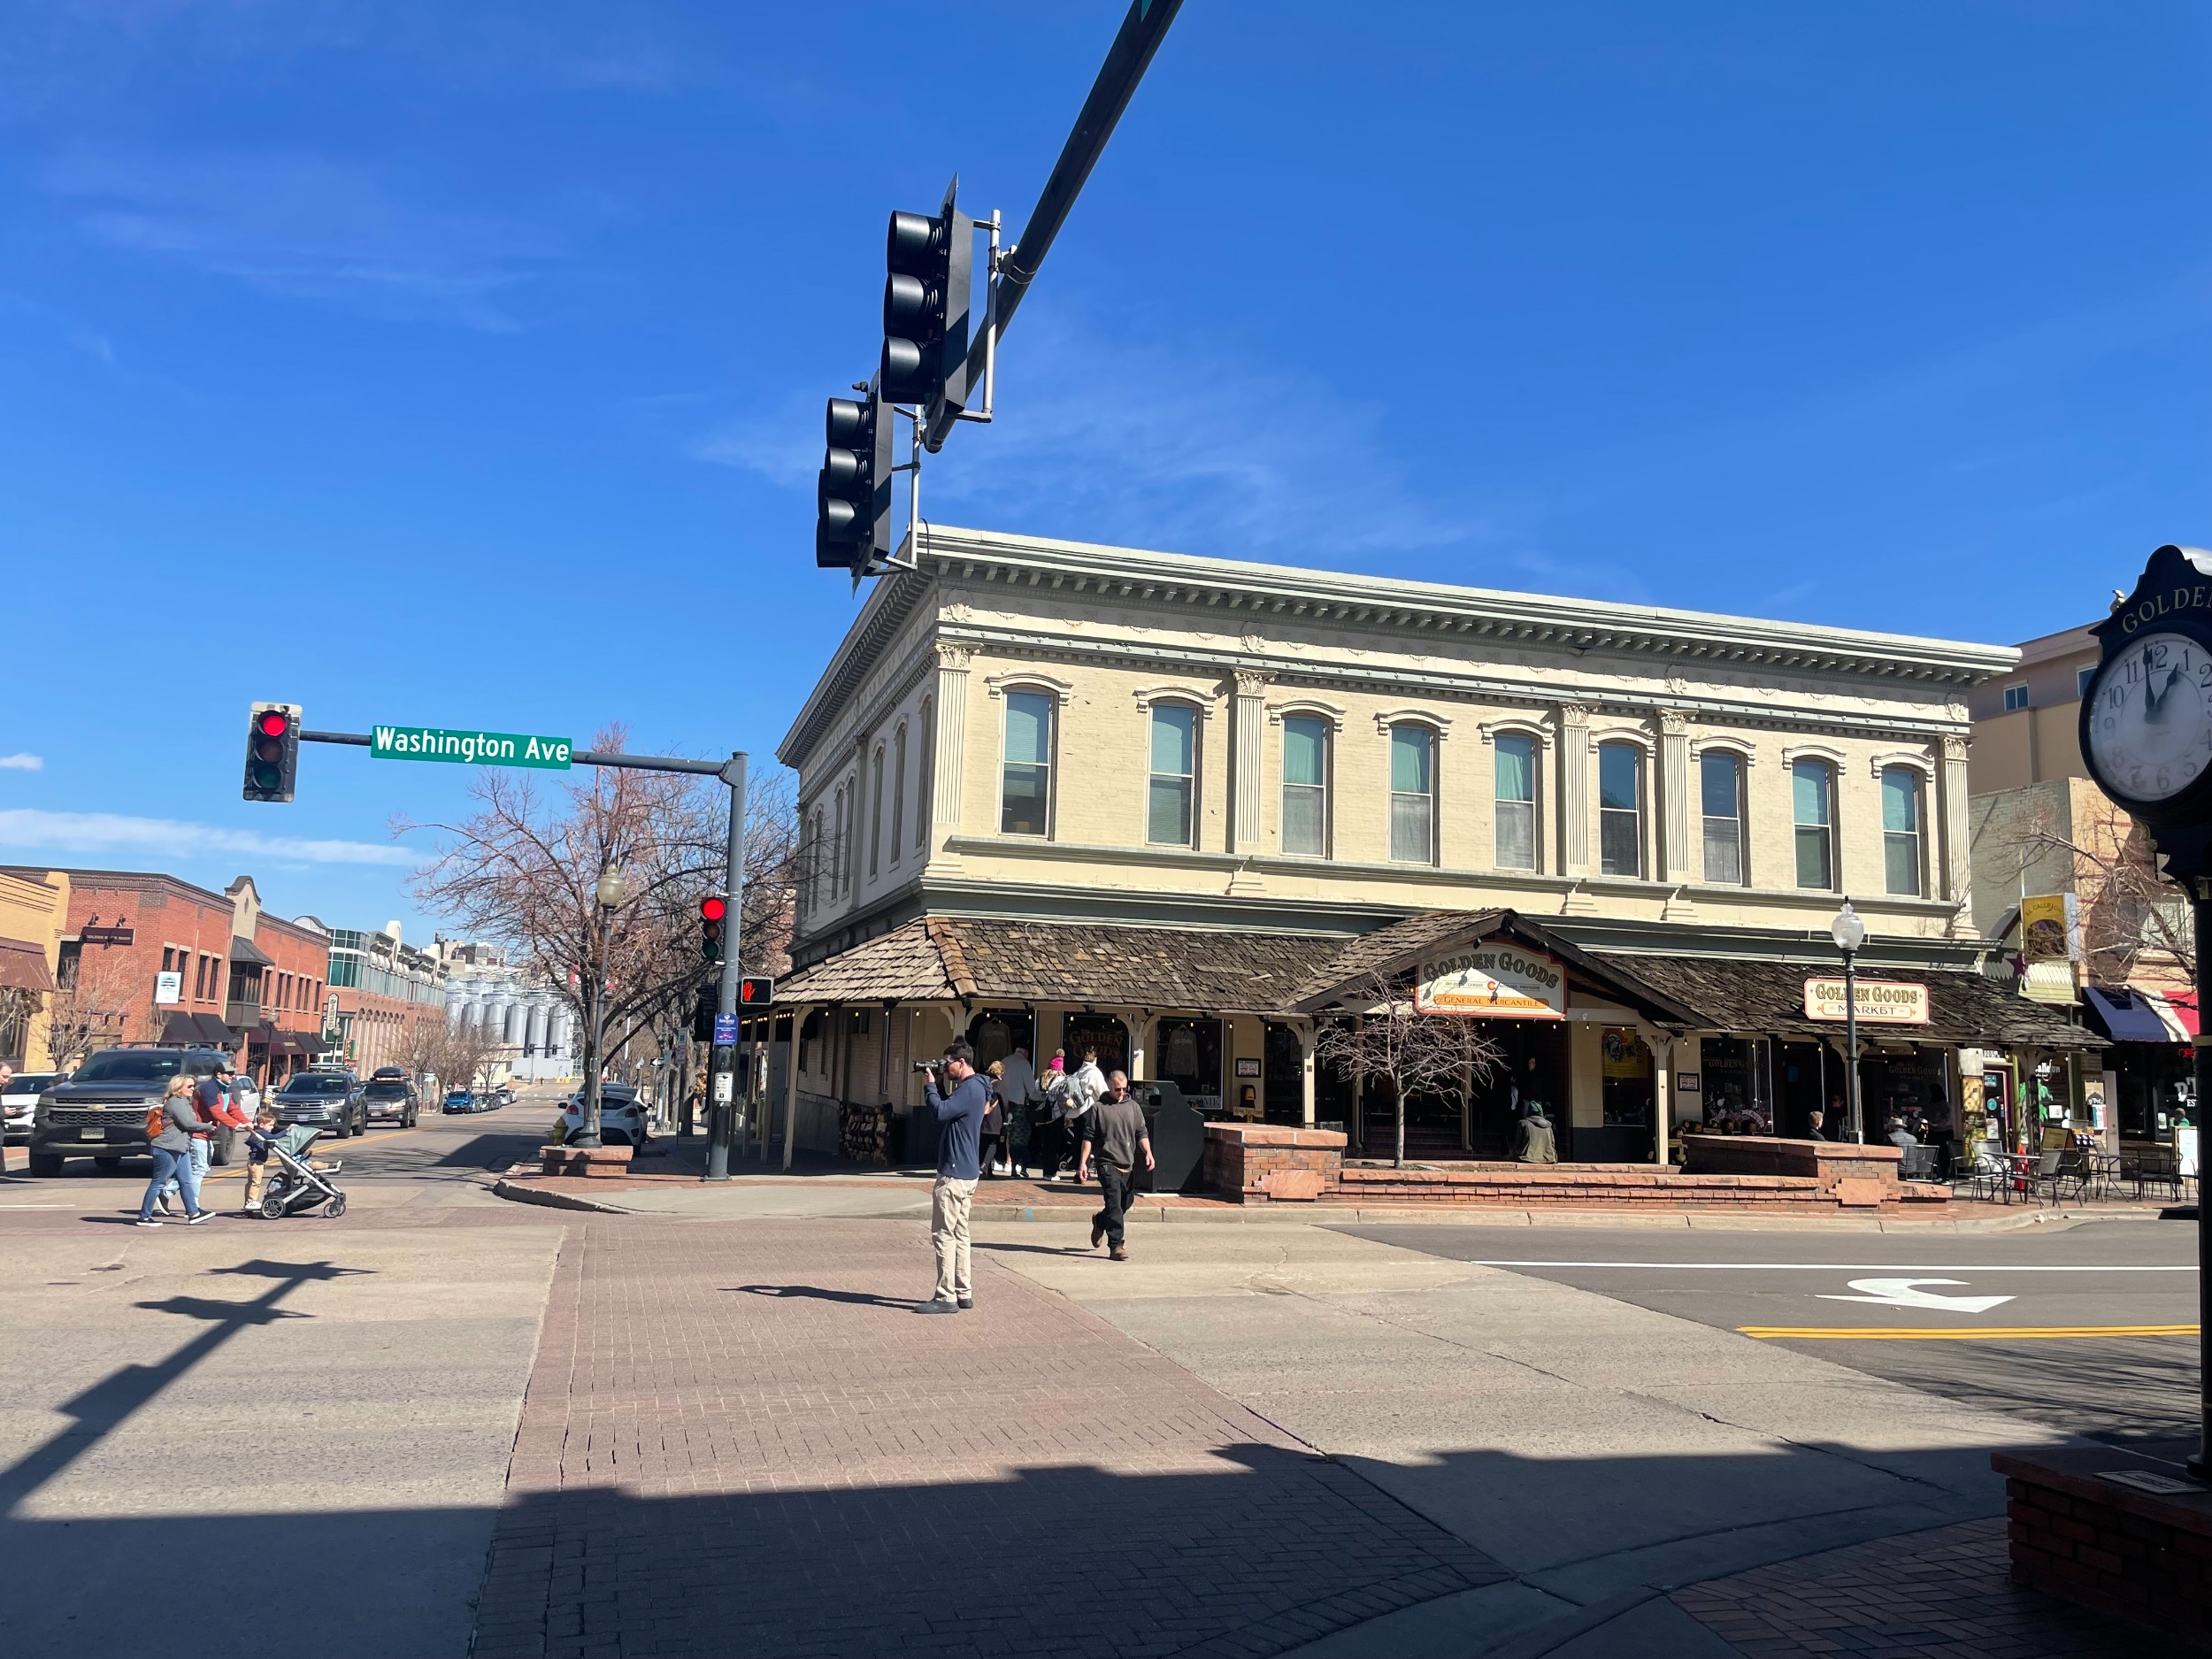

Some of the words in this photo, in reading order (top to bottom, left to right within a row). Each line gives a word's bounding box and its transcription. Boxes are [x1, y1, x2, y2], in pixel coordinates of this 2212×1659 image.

[2124, 660, 2139, 684] 11
[2183, 649, 2191, 672] 1
[2199, 663, 2212, 688] 2
[2107, 685, 2124, 710] 10
[2103, 717, 2116, 740] 9
[2199, 728, 2212, 751] 4
[376, 726, 515, 763] Washington
[525, 736, 570, 762] Ave
[2112, 746, 2124, 769] 8
[2183, 752, 2198, 777] 5
[2156, 765, 2170, 790] 6
[1424, 953, 1496, 982] GOLDEN
[1498, 952, 1560, 989] GOODS
[1444, 996, 1483, 1005] GENERAL
[1486, 997, 1540, 1008] MERCANTILE
[1816, 983, 1870, 1002] GOLEN
[1872, 986, 1918, 1004] GOODS
[1069, 1030, 1124, 1048] GOLDEN
